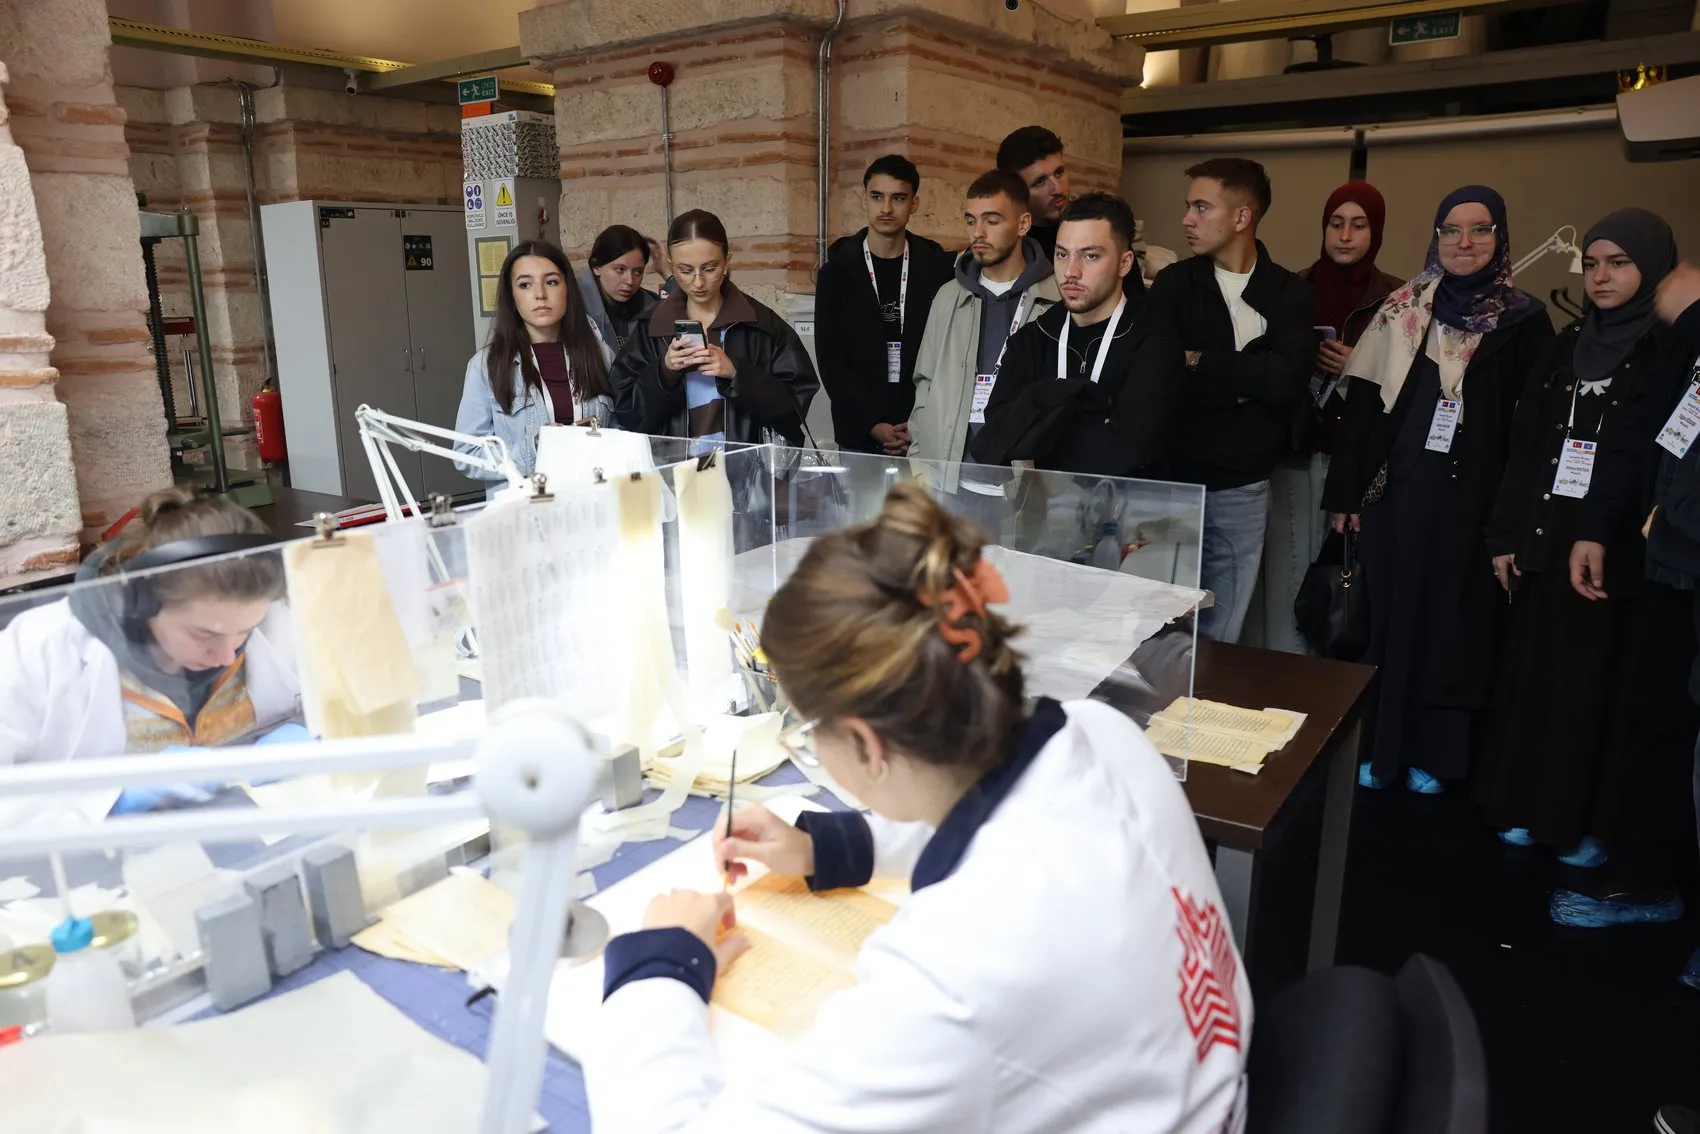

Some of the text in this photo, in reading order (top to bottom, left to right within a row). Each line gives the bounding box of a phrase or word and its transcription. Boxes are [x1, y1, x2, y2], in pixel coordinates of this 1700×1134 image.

[1432, 26, 1455, 36] EXIT
[482, 89, 494, 97] EXIT
[420, 257, 432, 267] 90
